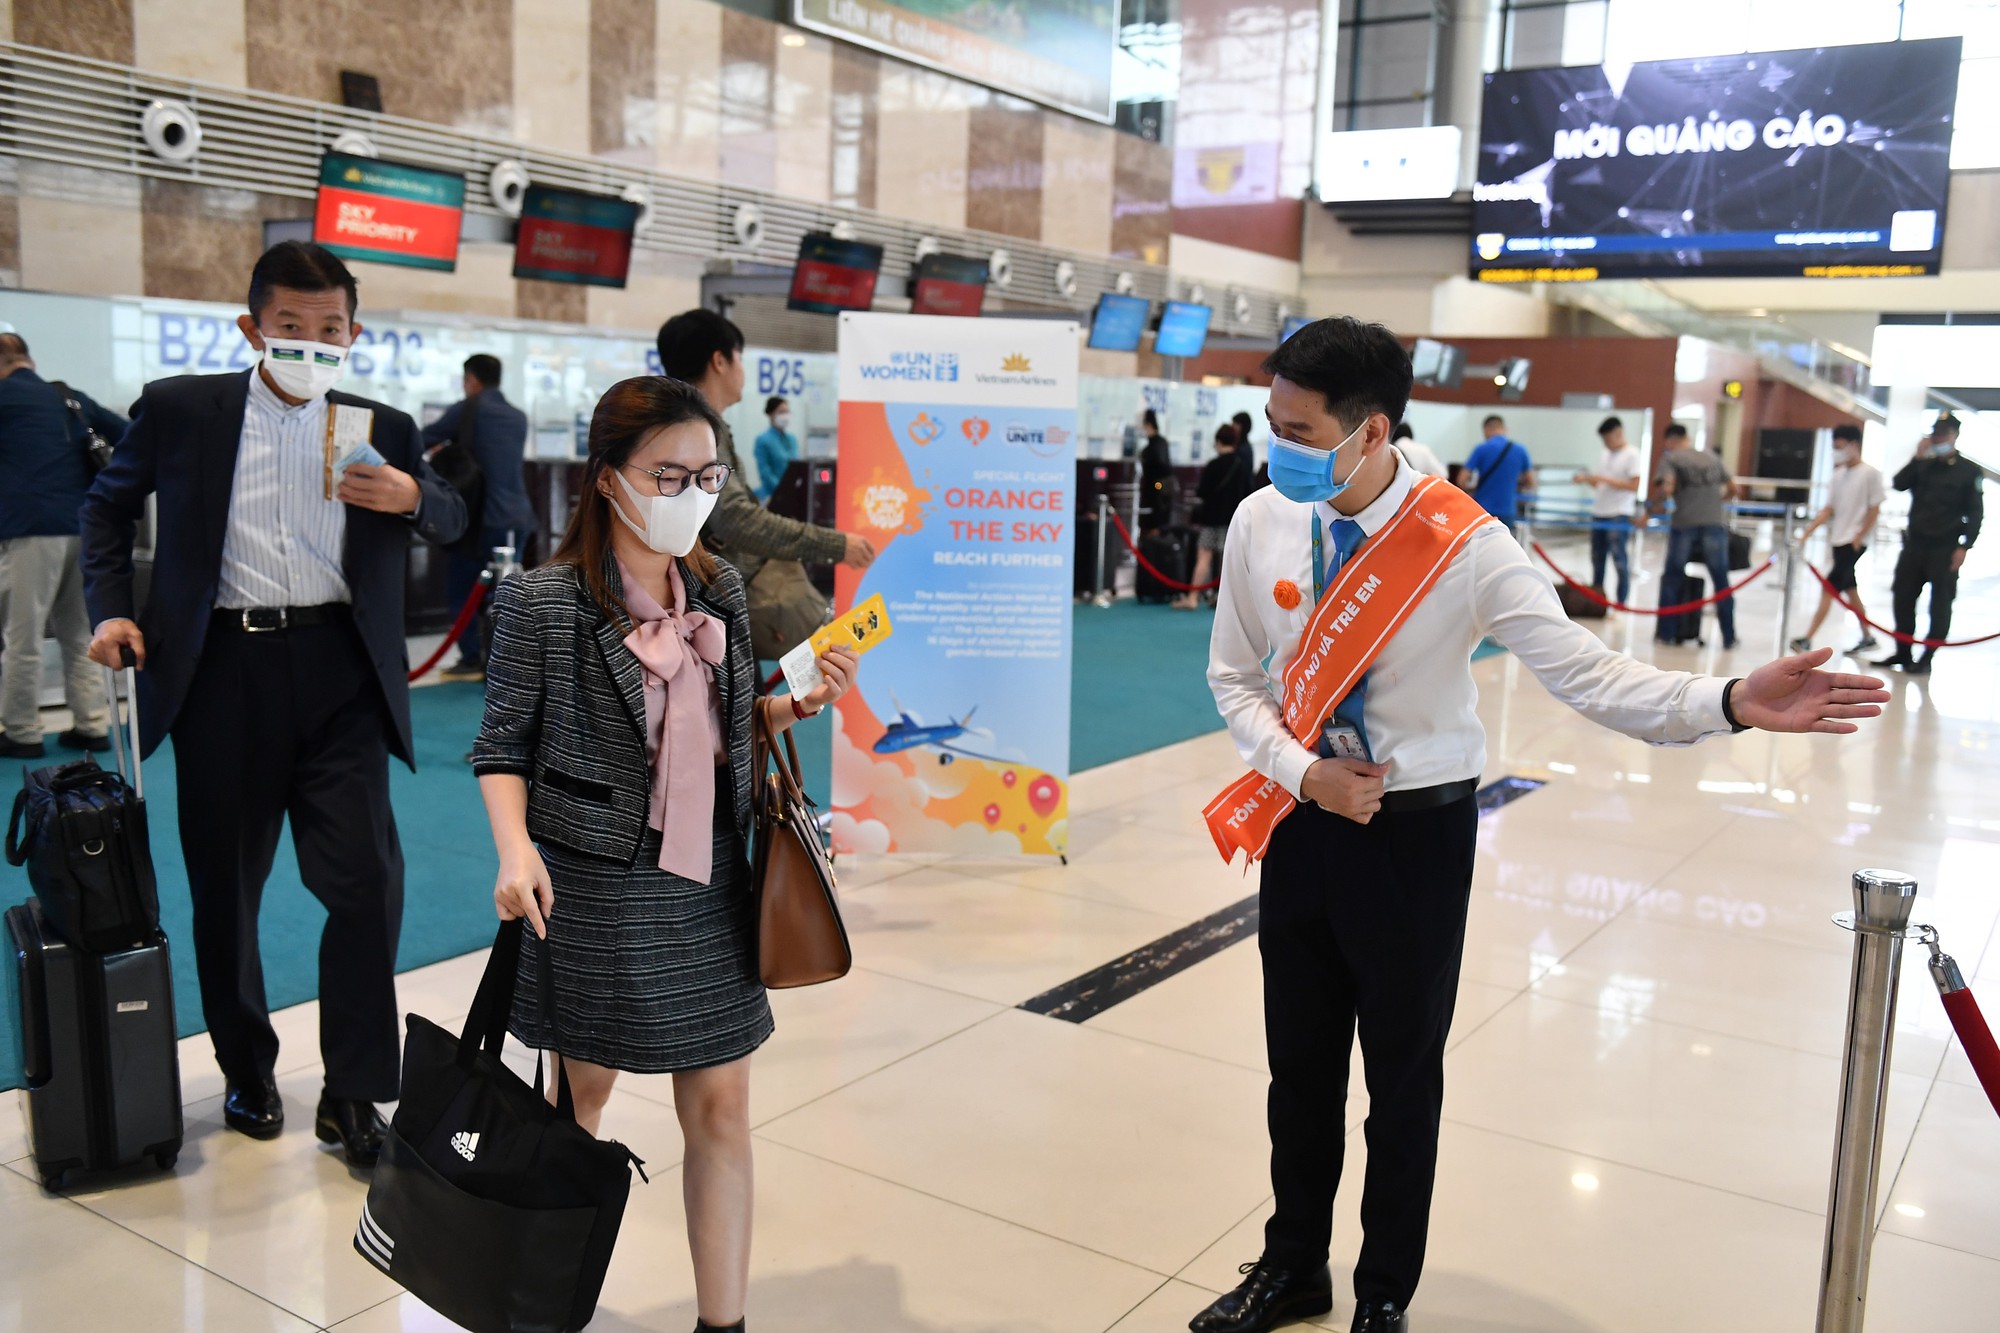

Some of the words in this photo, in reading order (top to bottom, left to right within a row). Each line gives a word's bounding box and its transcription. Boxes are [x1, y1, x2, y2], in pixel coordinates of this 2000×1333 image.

[1553, 121, 1621, 160] MỜI
[1625, 114, 1756, 156] QUẢNG
[1762, 108, 1847, 149] CÁO
[338, 202, 376, 220] SKY
[336, 219, 418, 244] PRIORITY
[159, 313, 249, 368] B22
[907, 353, 932, 365] UN
[758, 357, 804, 396] B25
[860, 364, 932, 381] WOMEN
[1006, 432, 1044, 444] UNITE
[973, 470, 1020, 482] SPECIAL
[1023, 471, 1066, 483] FLIGHT
[945, 488, 1064, 511] ORANGE
[950, 520, 1004, 542] THE
[1012, 521, 1064, 543] SKY
[933, 551, 987, 566] REACH
[992, 552, 1063, 568] FURTHER
[1329, 599, 1361, 634] TRẺ
[1354, 573, 1382, 604] EM
[1226, 797, 1260, 829] TÔN
[450, 1136, 475, 1162] adidas
